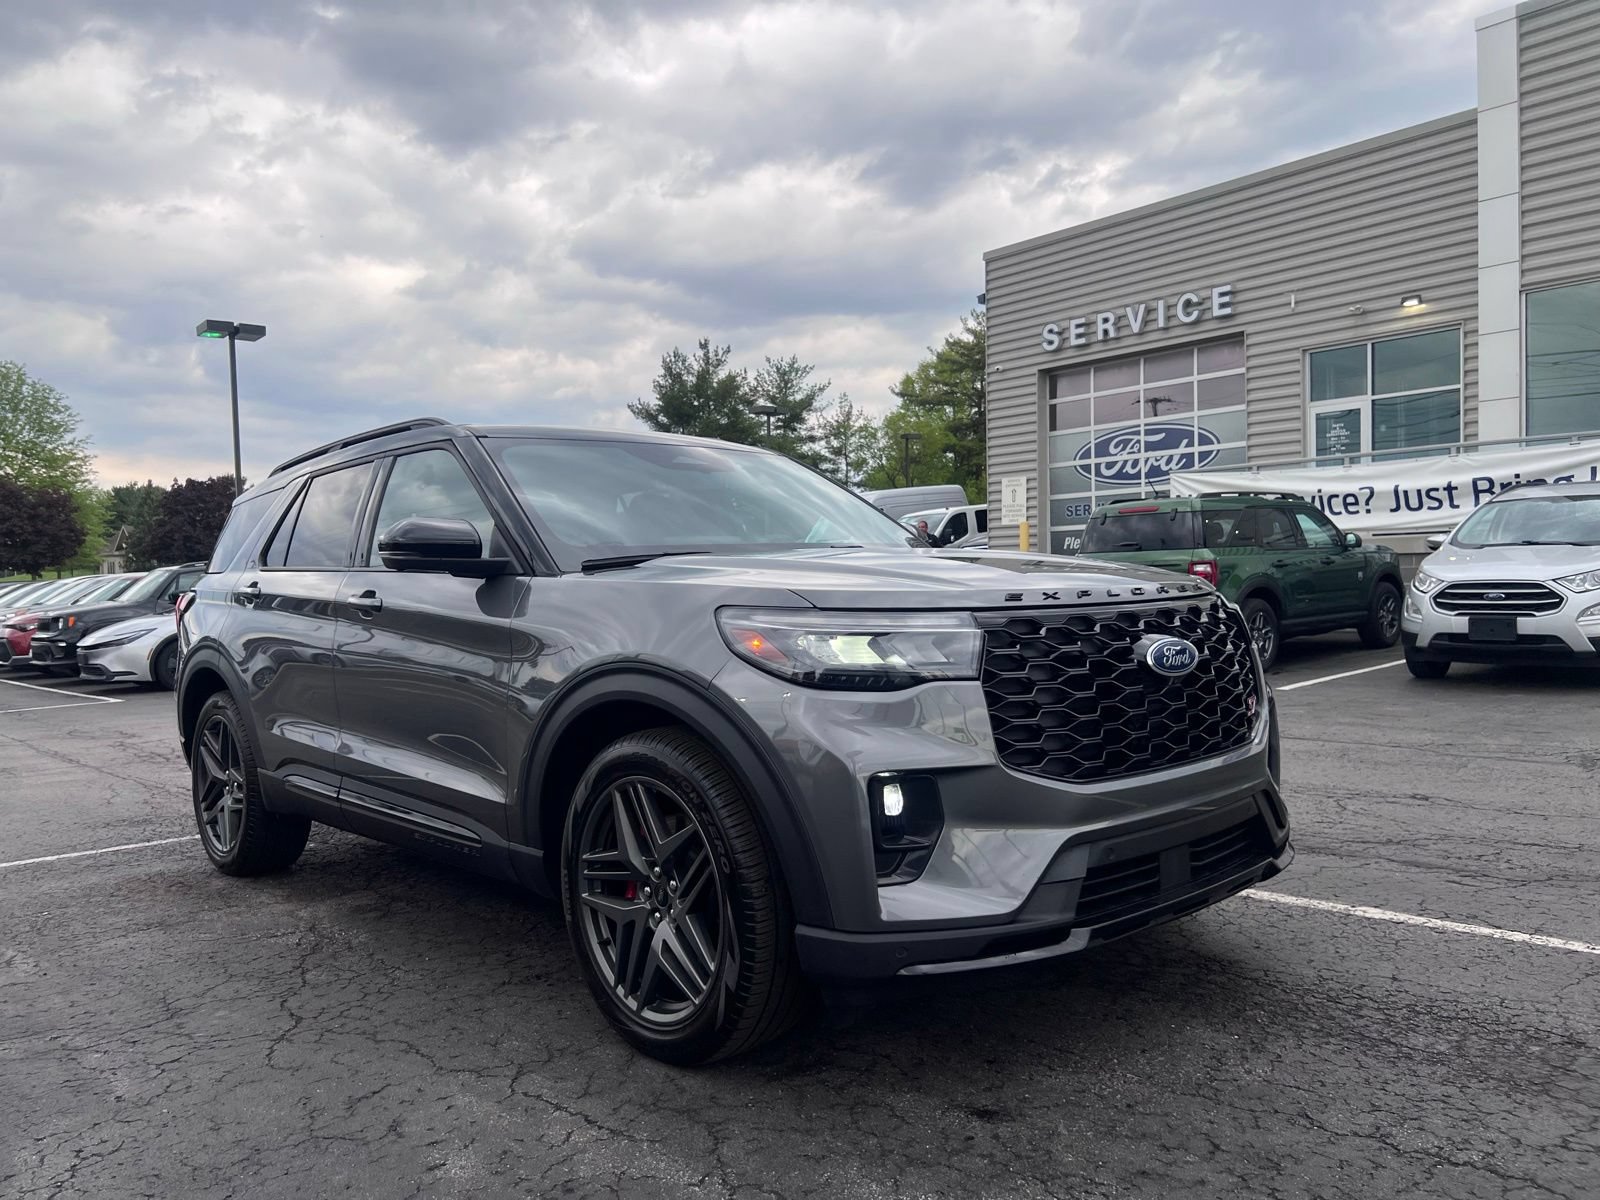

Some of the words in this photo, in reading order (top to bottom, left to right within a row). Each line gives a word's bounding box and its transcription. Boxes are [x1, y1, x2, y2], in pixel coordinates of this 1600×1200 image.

[1042, 285, 1232, 351] SERVICE
[1100, 432, 1190, 477] Ford
[1389, 480, 1460, 513] Just
[1065, 503, 1105, 518] SER
[1004, 583, 1203, 602] EXPLORER
[1163, 645, 1191, 667] Ford
